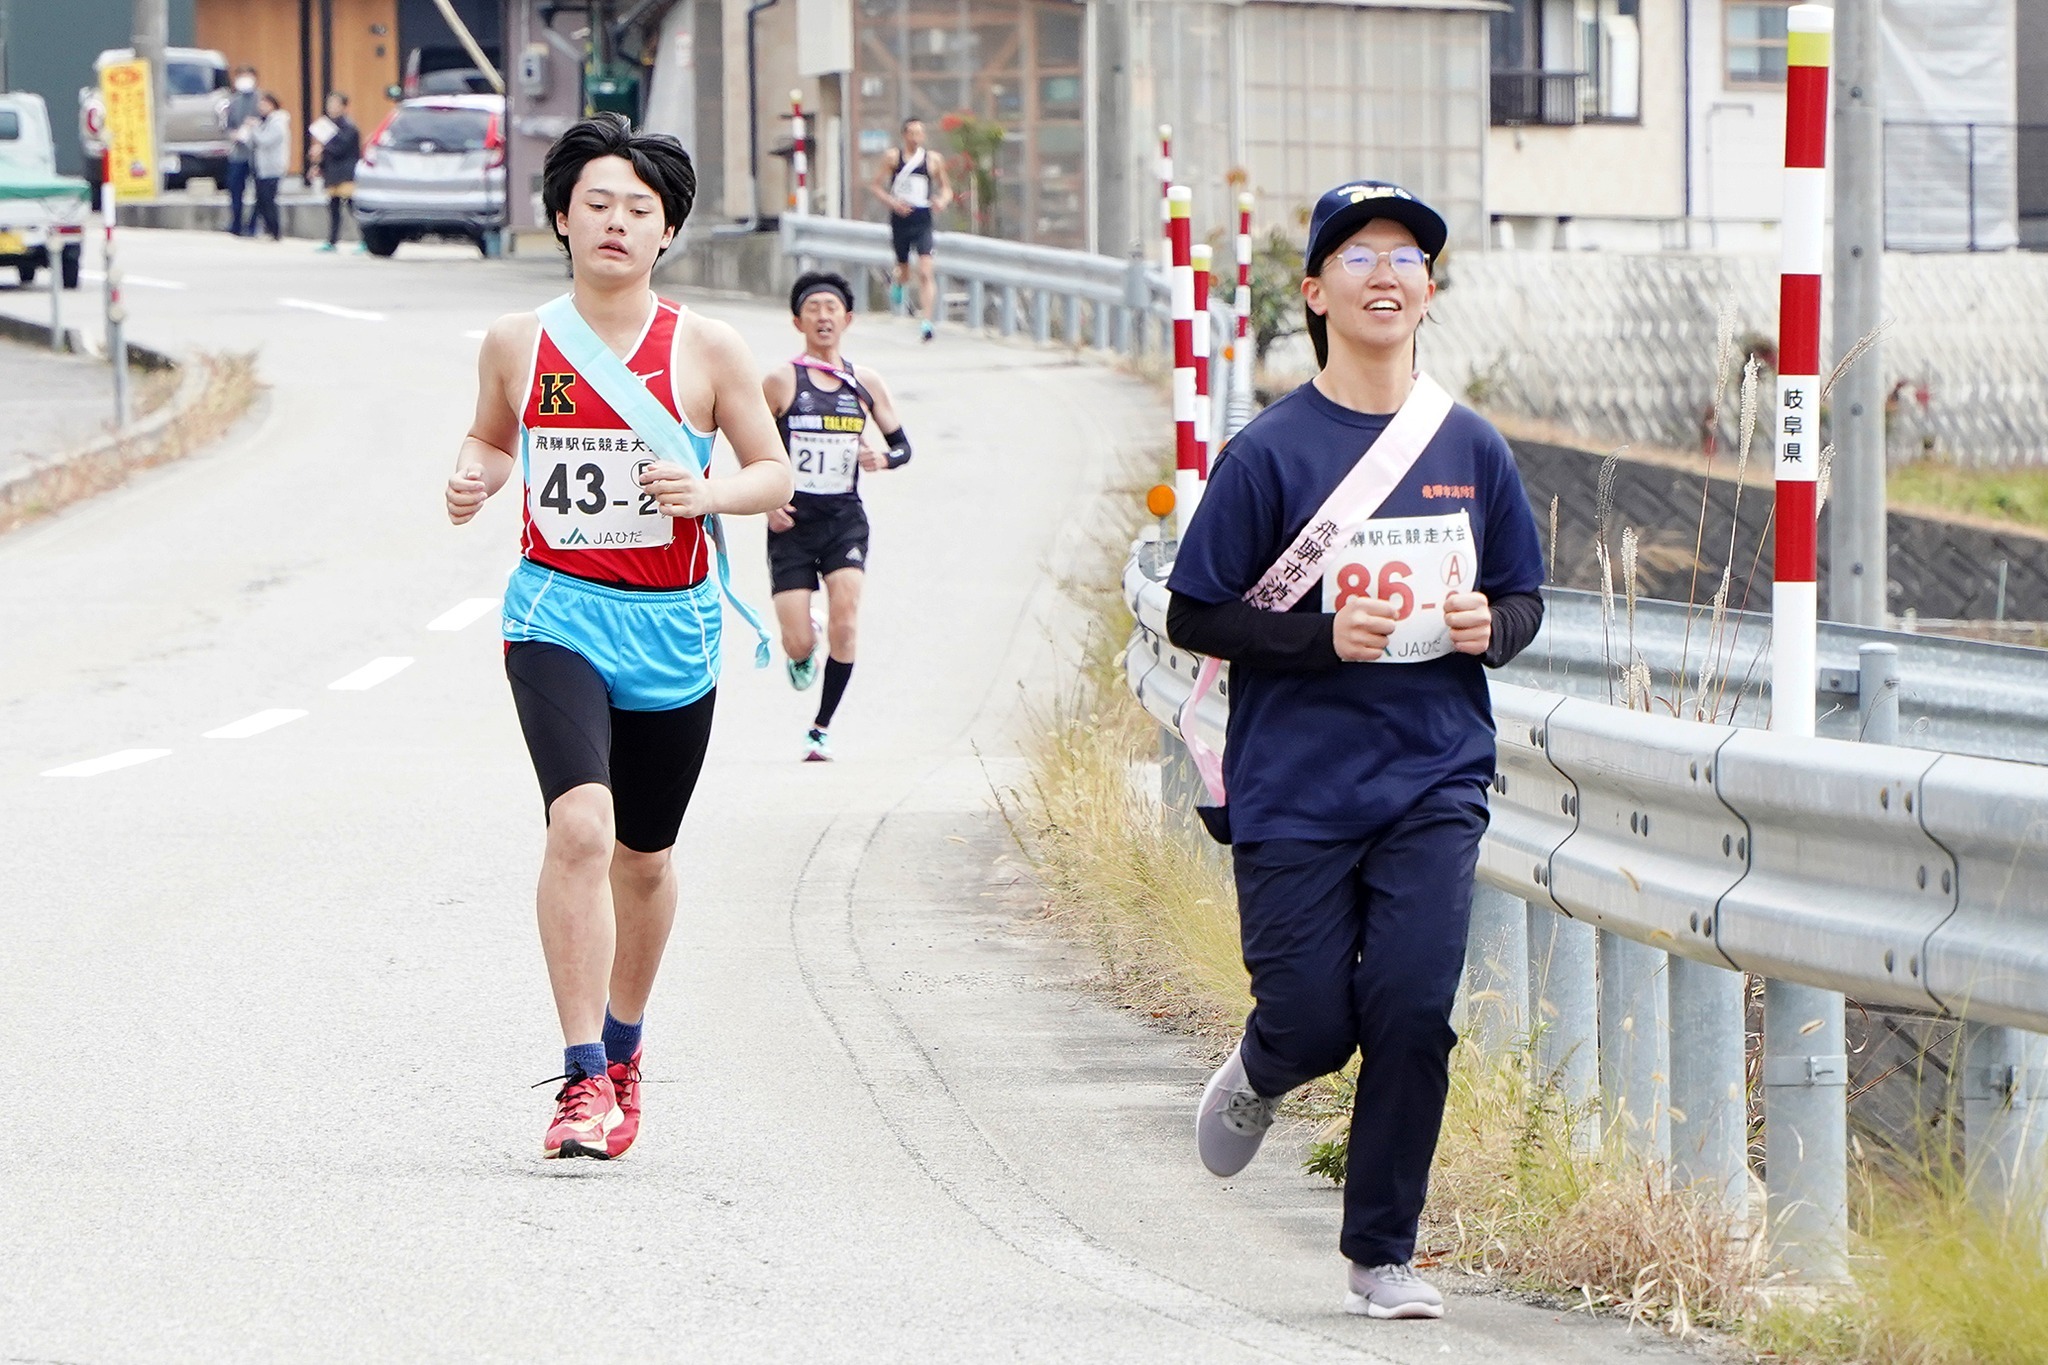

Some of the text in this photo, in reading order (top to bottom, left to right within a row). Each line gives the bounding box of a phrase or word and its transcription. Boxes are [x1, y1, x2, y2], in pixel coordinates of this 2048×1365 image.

[538, 373, 576, 415] K
[1782, 388, 1804, 463] 岐阜県
[535, 435, 654, 452] 飛騨駅伝競走大
[540, 463, 658, 516] 43-2
[593, 530, 643, 545] JAひだ
[1343, 527, 1466, 548] 騨駅伝競走大会
[1446, 555, 1462, 586] A
[1334, 560, 1460, 622] 86-
[1397, 638, 1442, 657] JAひだ
